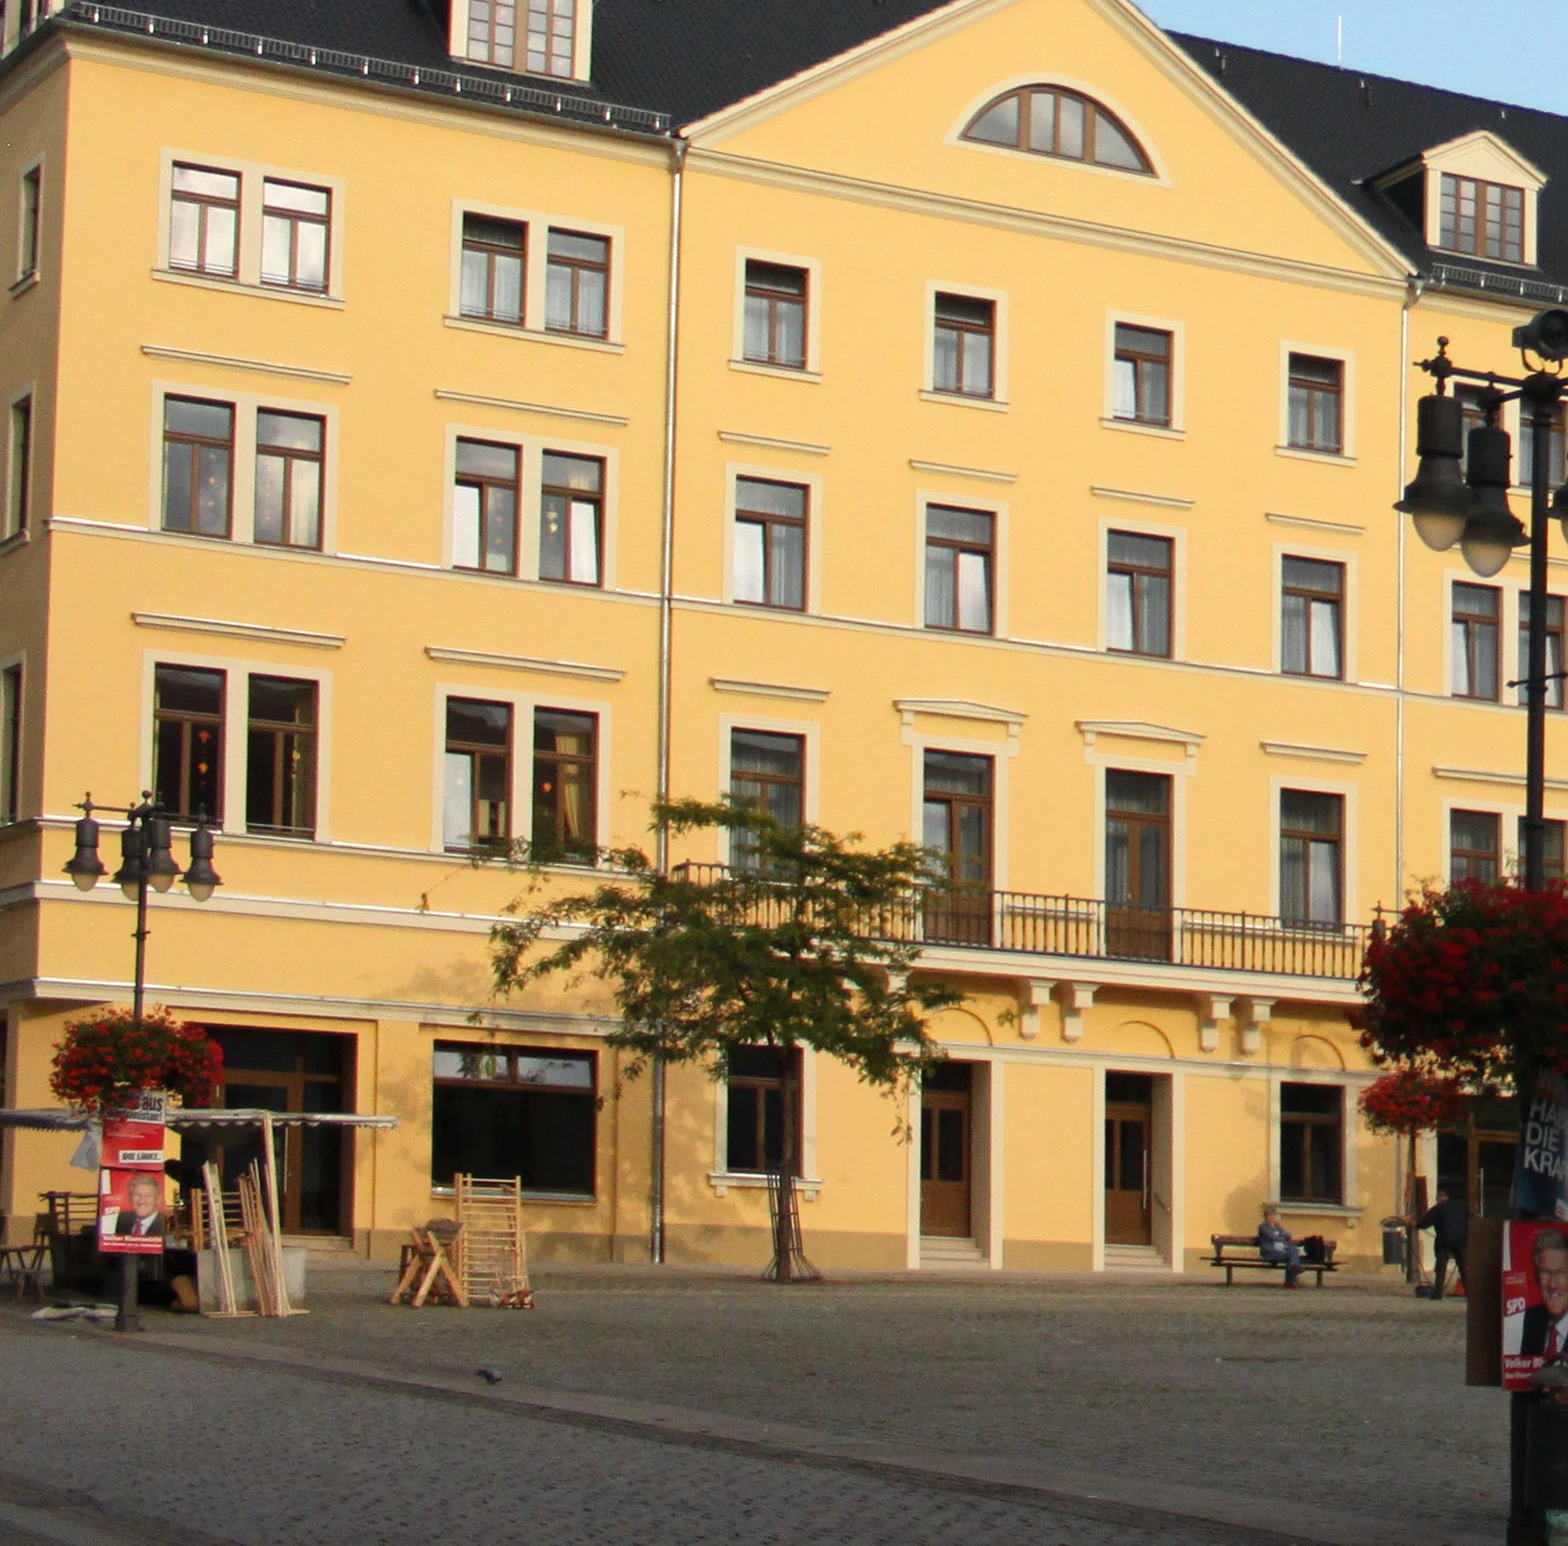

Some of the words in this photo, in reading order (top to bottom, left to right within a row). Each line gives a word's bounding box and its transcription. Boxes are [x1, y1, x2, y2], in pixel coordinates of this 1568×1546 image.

[1525, 1121, 1560, 1153] DIE
[1505, 1296, 1526, 1315] SPD
[1505, 1357, 1531, 1368] Volker
